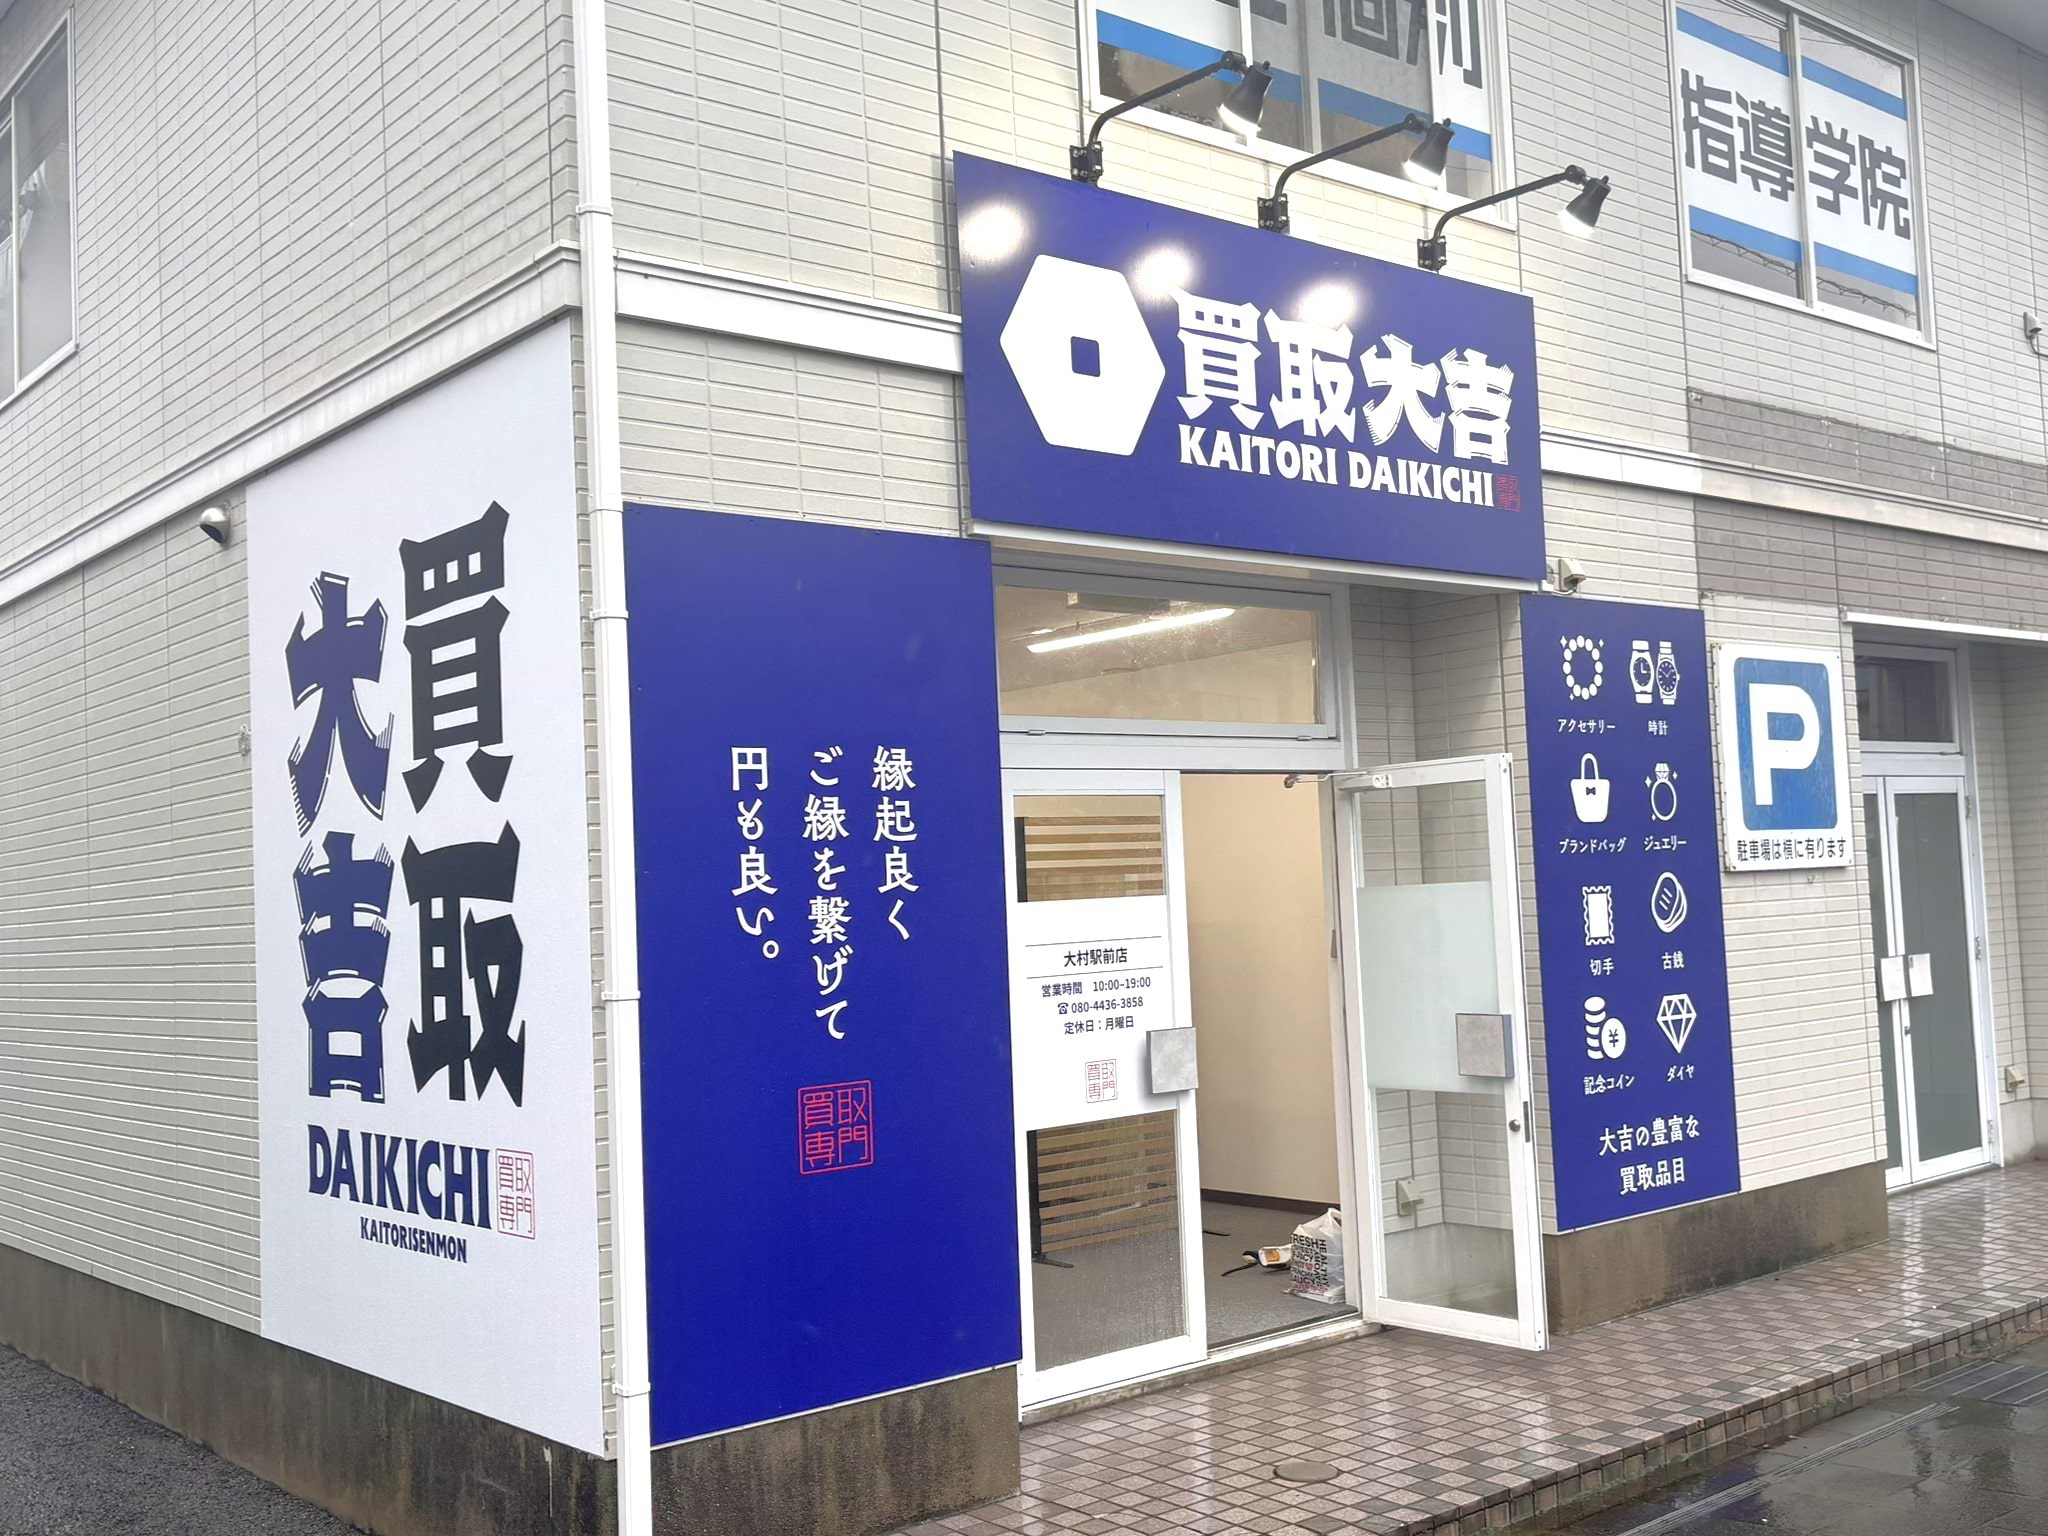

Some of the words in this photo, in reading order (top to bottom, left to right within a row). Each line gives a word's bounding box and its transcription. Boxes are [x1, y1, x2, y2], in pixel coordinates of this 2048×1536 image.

[1680, 68, 1911, 240] 指導学院
[1173, 288, 1515, 466] 買取大吉
[1178, 404, 1338, 485] KAITORI
[1347, 450, 1495, 507] DAIKICHI
[1557, 718, 1616, 734] アクセサリー
[1648, 720, 1668, 735] 時計
[1748, 683, 1821, 806] P
[400, 500, 526, 1108] 買取
[285, 570, 395, 1104] 大吉
[731, 746, 780, 959] 円も良い。
[871, 744, 918, 940] 縁起良く
[1559, 836, 1627, 854] ブランドバッグ
[1643, 834, 1687, 852] ジュエリー
[1737, 837, 1846, 862] 駐車場は横に有ります
[802, 744, 854, 1040] ご縁を繋げて
[1063, 947, 1128, 967] 大村駅前店
[1589, 957, 1614, 976] 切手
[1661, 951, 1684, 970] 古銭
[1041, 981, 1083, 998] 営業時間
[1071, 996, 1144, 1014] 080-4436-3858
[1584, 1074, 1634, 1095] 記念コイン
[1667, 1065, 1694, 1082] ダイヤ
[1599, 1114, 1700, 1157] 大吉の豊富な
[307, 1124, 493, 1230] DAIKICHI
[1620, 1157, 1685, 1195] 買取品目
[360, 1216, 467, 1263] KAITORISENMON
[1319, 1239, 1330, 1287] HEALTHY
